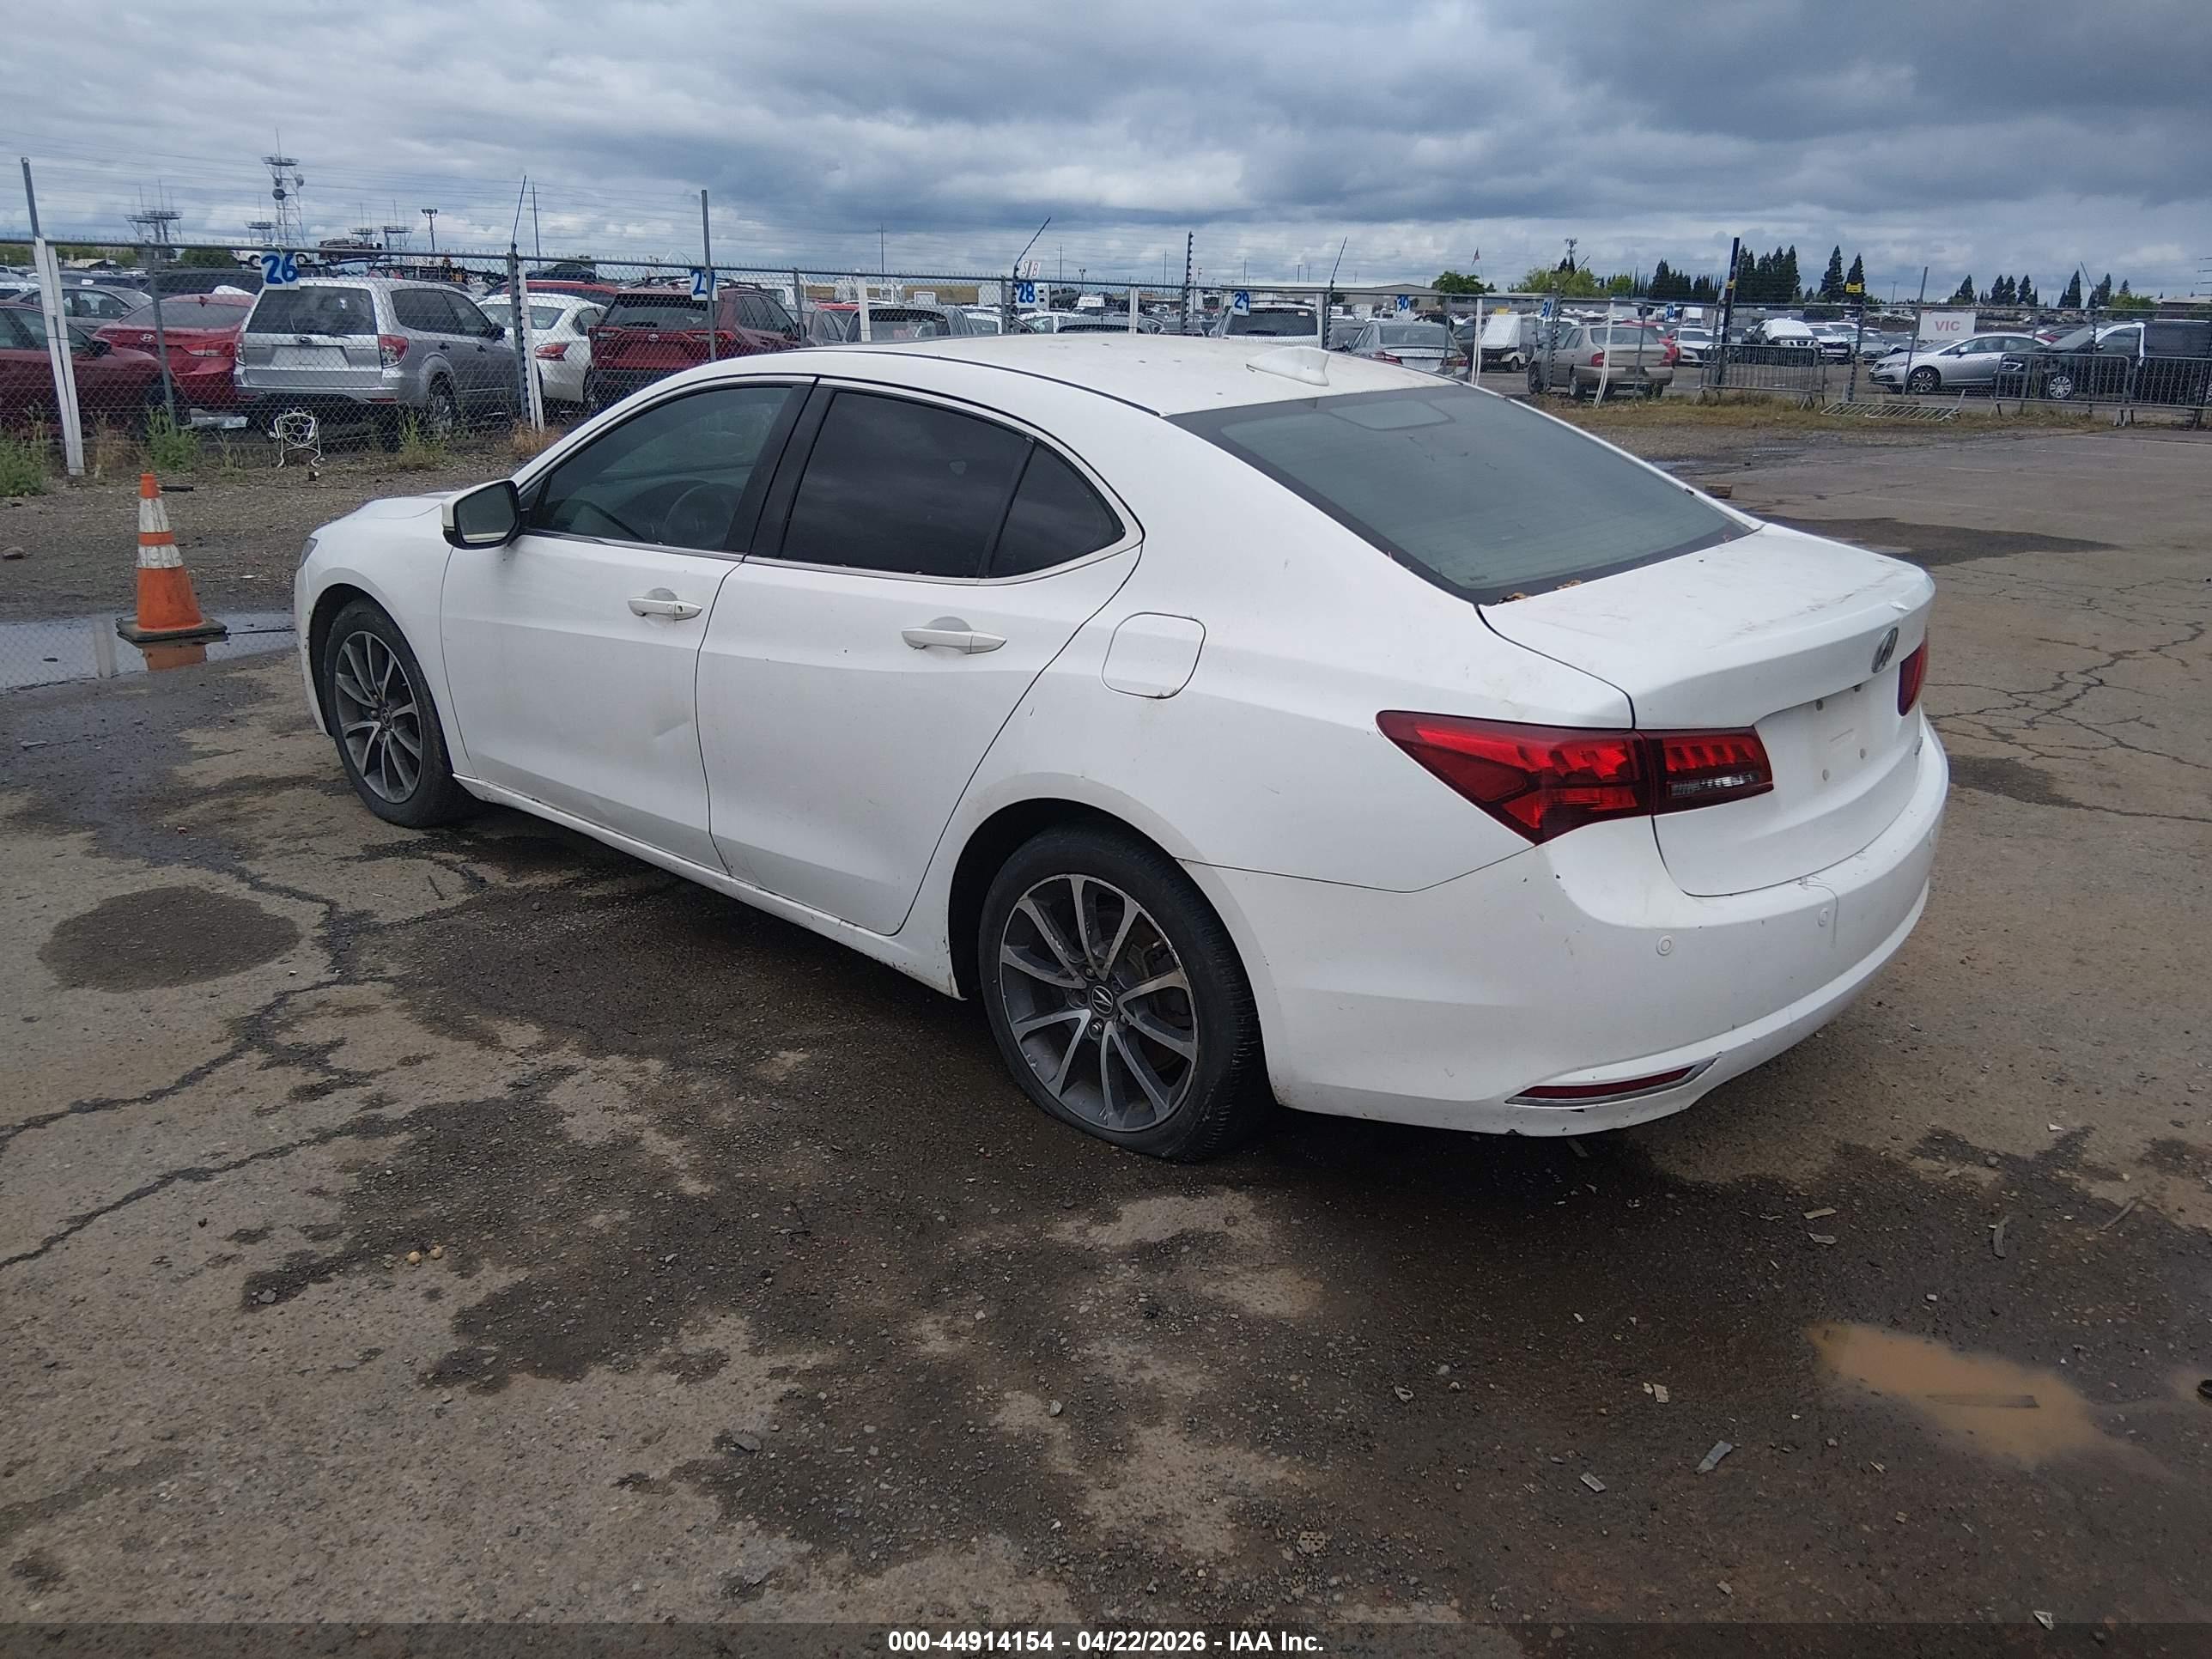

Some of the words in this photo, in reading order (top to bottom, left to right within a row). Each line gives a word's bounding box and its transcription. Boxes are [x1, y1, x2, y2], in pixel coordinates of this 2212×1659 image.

[261, 253, 297, 284] 26
[1017, 282, 1035, 303] 28
[1234, 289, 1249, 311] 29
[1541, 301, 1552, 317] 31
[1935, 320, 1960, 331] VIC
